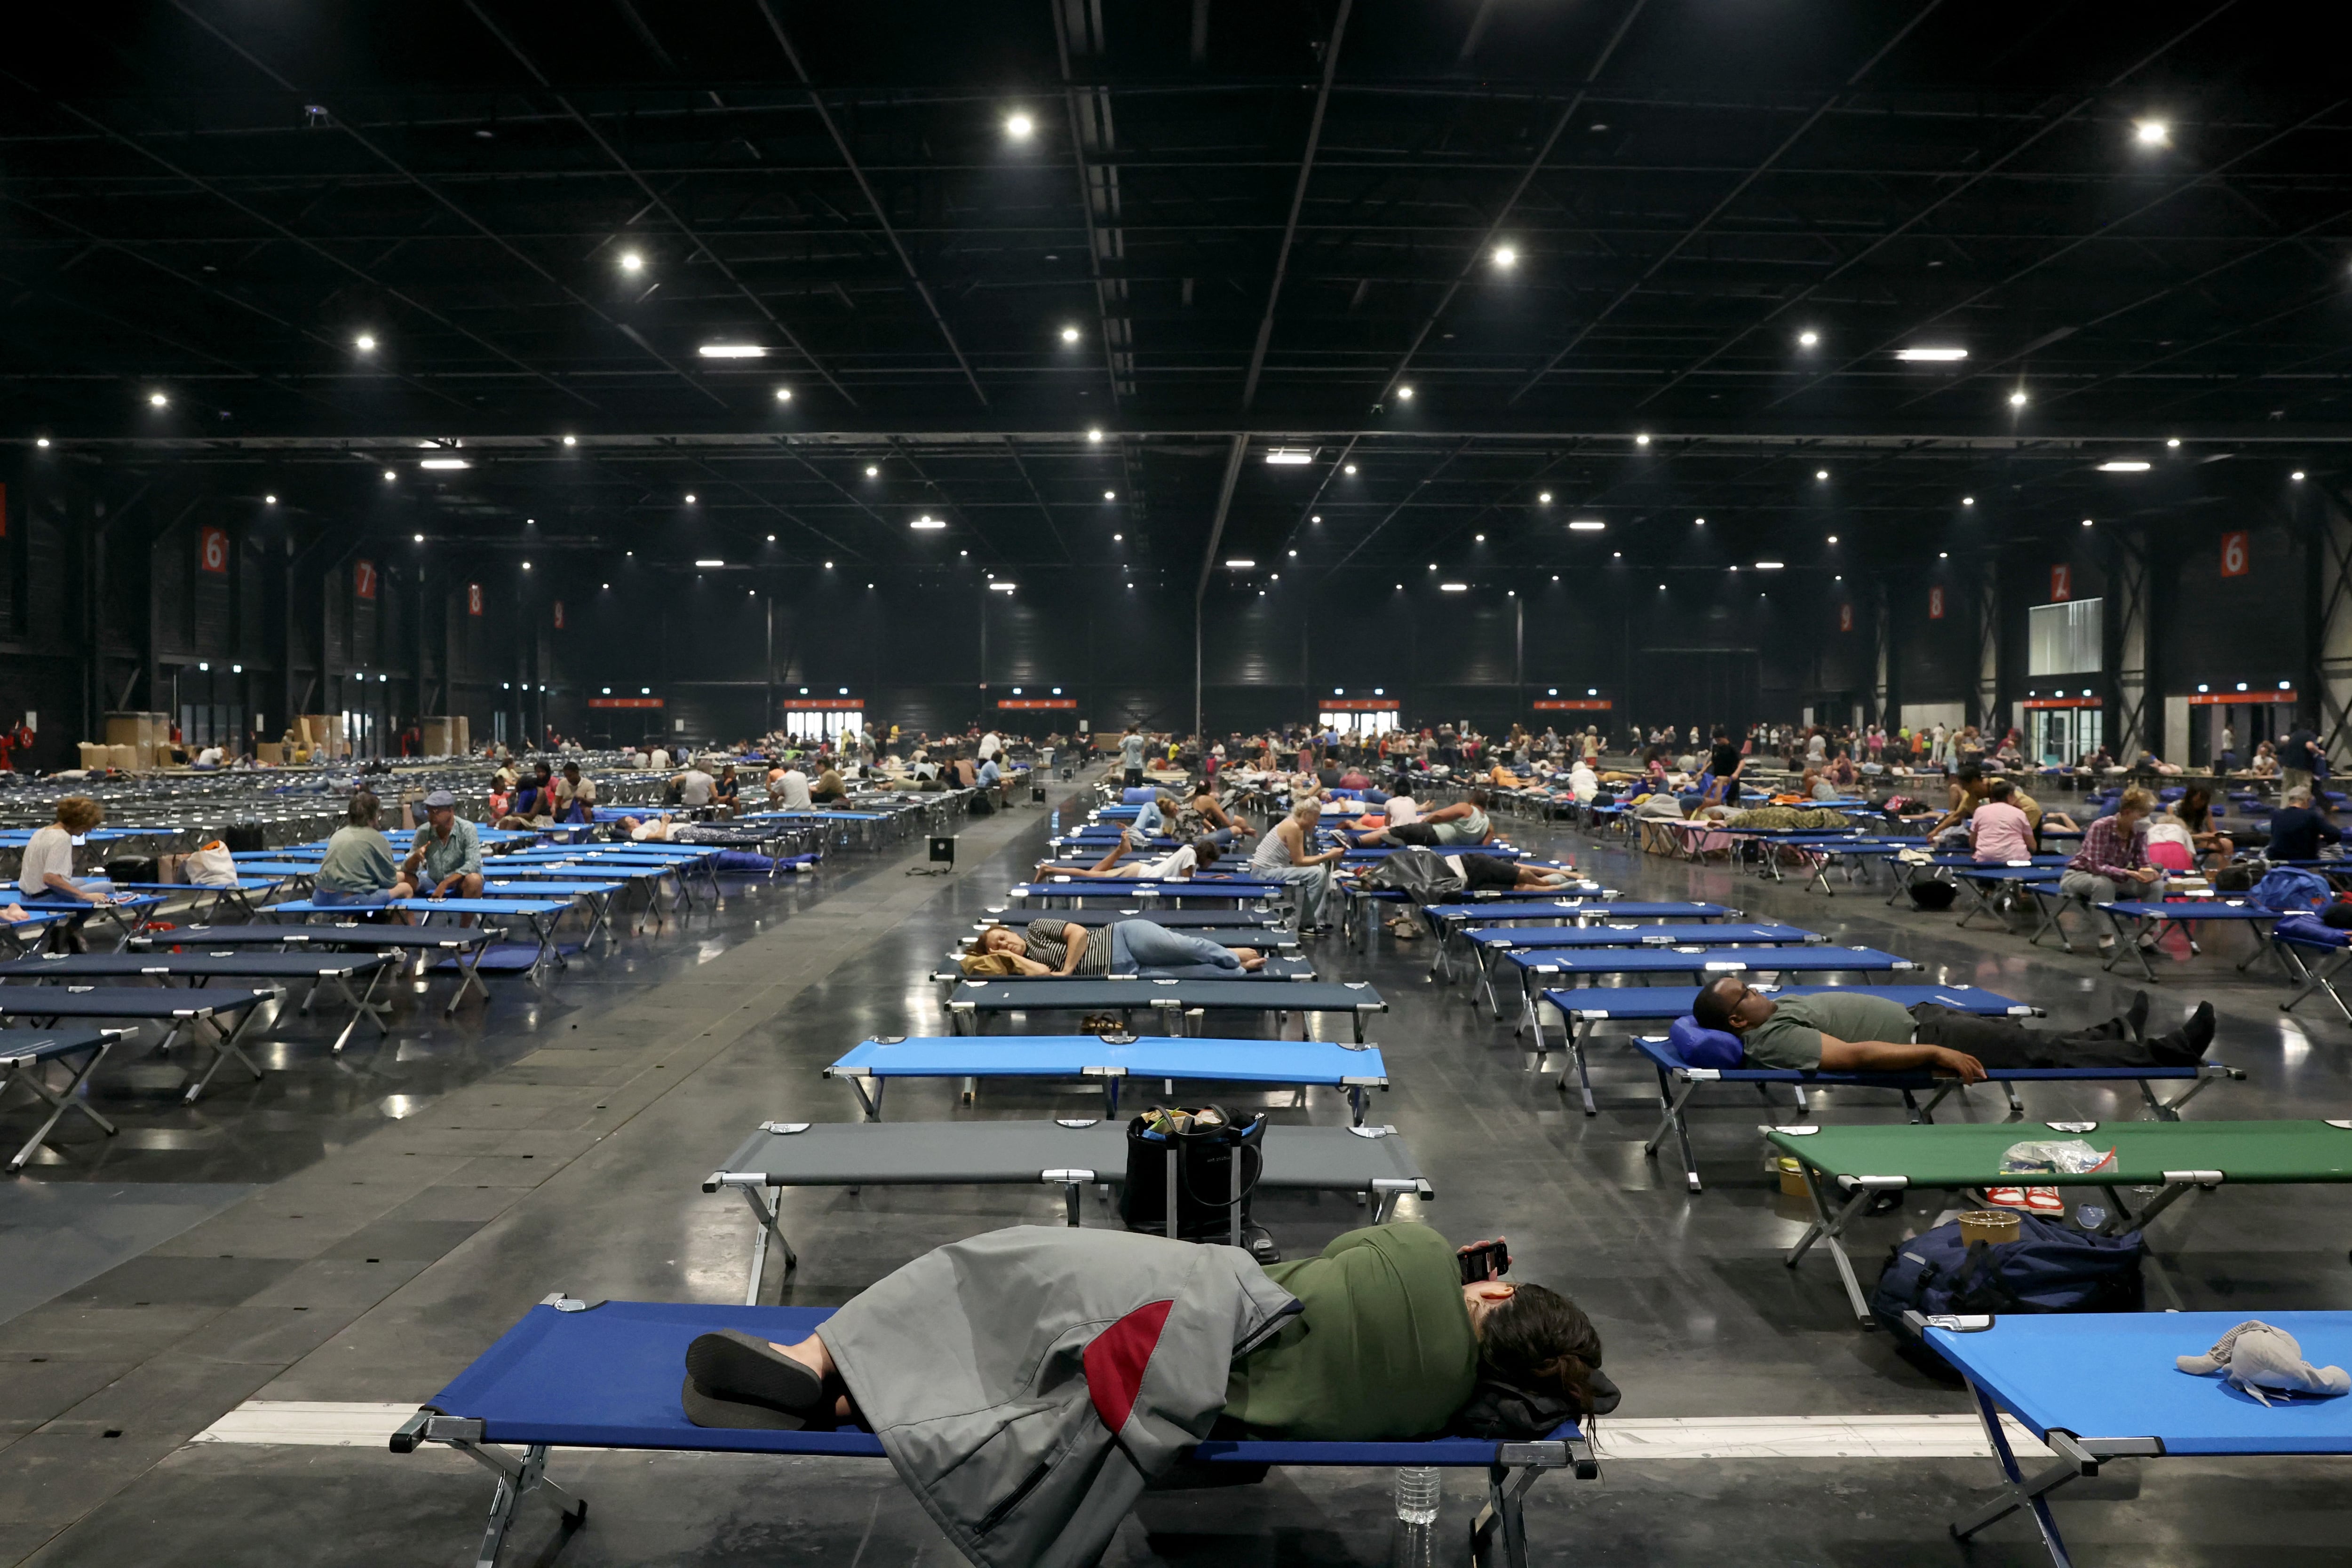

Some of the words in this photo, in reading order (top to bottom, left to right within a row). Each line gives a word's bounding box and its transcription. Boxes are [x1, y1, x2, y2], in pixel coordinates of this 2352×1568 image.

[207, 532, 222, 568] 6
[2226, 535, 2243, 572] 6
[361, 563, 371, 593] 7
[472, 585, 480, 611] 8
[1932, 588, 1941, 616] 8
[556, 603, 562, 625] 9
[1843, 605, 1850, 629] 9
